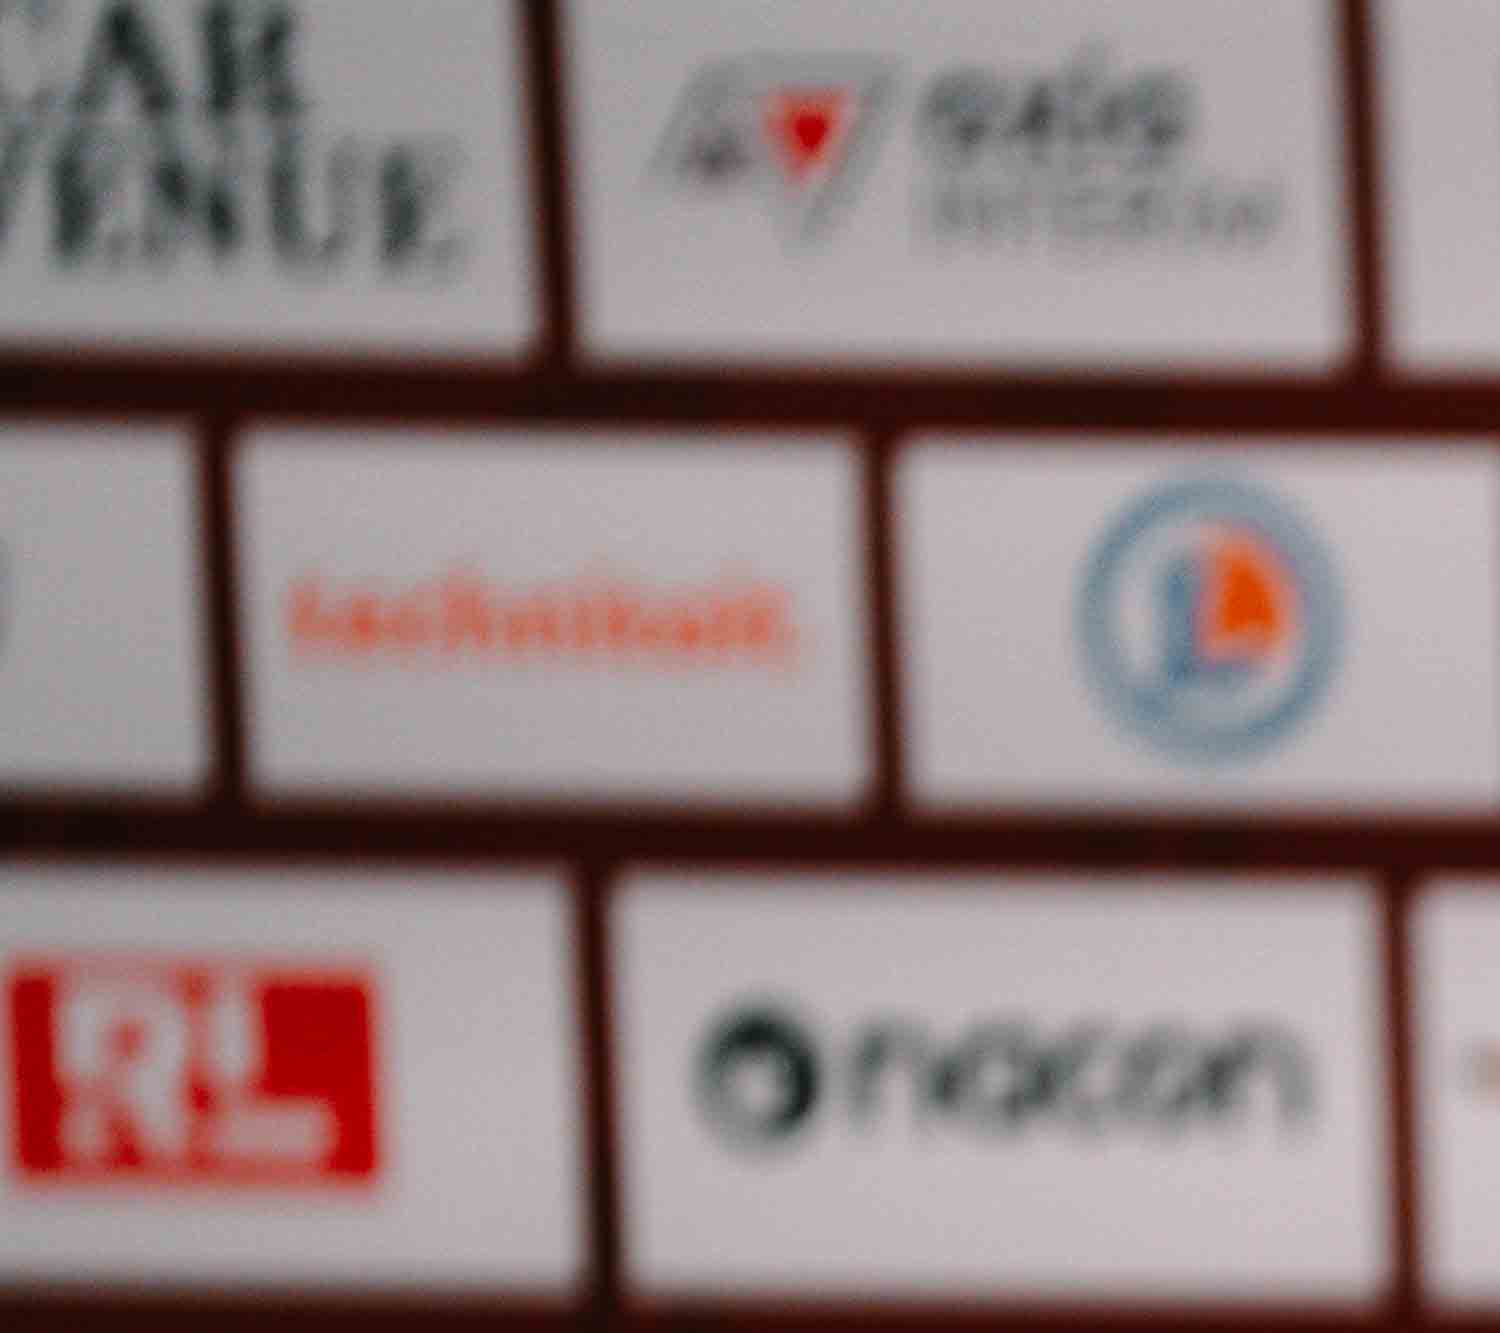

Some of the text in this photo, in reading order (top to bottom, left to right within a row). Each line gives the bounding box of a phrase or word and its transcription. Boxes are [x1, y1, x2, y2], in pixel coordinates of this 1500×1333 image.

[0, 0, 310, 122] AR
[0, 118, 472, 285] ENUE
[846, 1005, 1315, 1142] nacon
